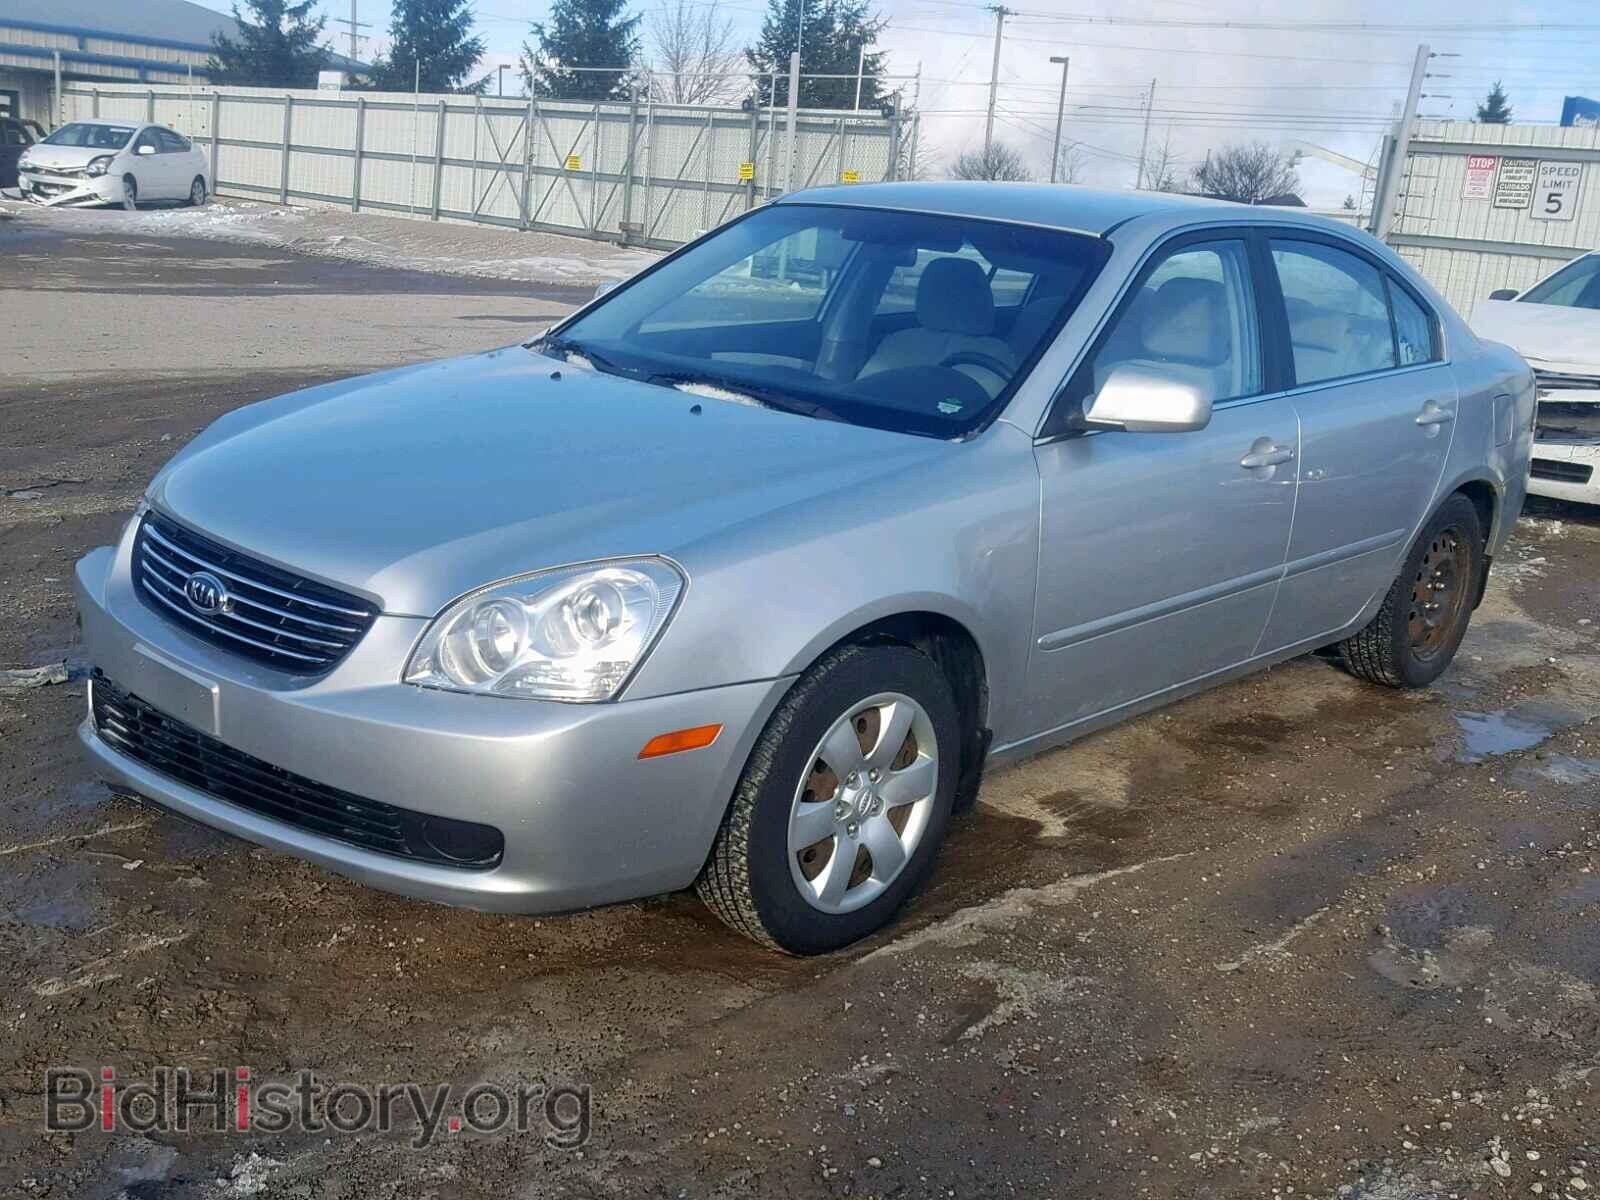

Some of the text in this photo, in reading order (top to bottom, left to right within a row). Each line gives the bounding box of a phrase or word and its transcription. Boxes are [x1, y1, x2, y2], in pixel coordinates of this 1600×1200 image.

[1470, 158, 1494, 168] STOP
[1541, 166, 1580, 177] SPEED
[1542, 180, 1575, 189] LIMIT
[1544, 193, 1562, 214] 5
[191, 580, 216, 608] KIA
